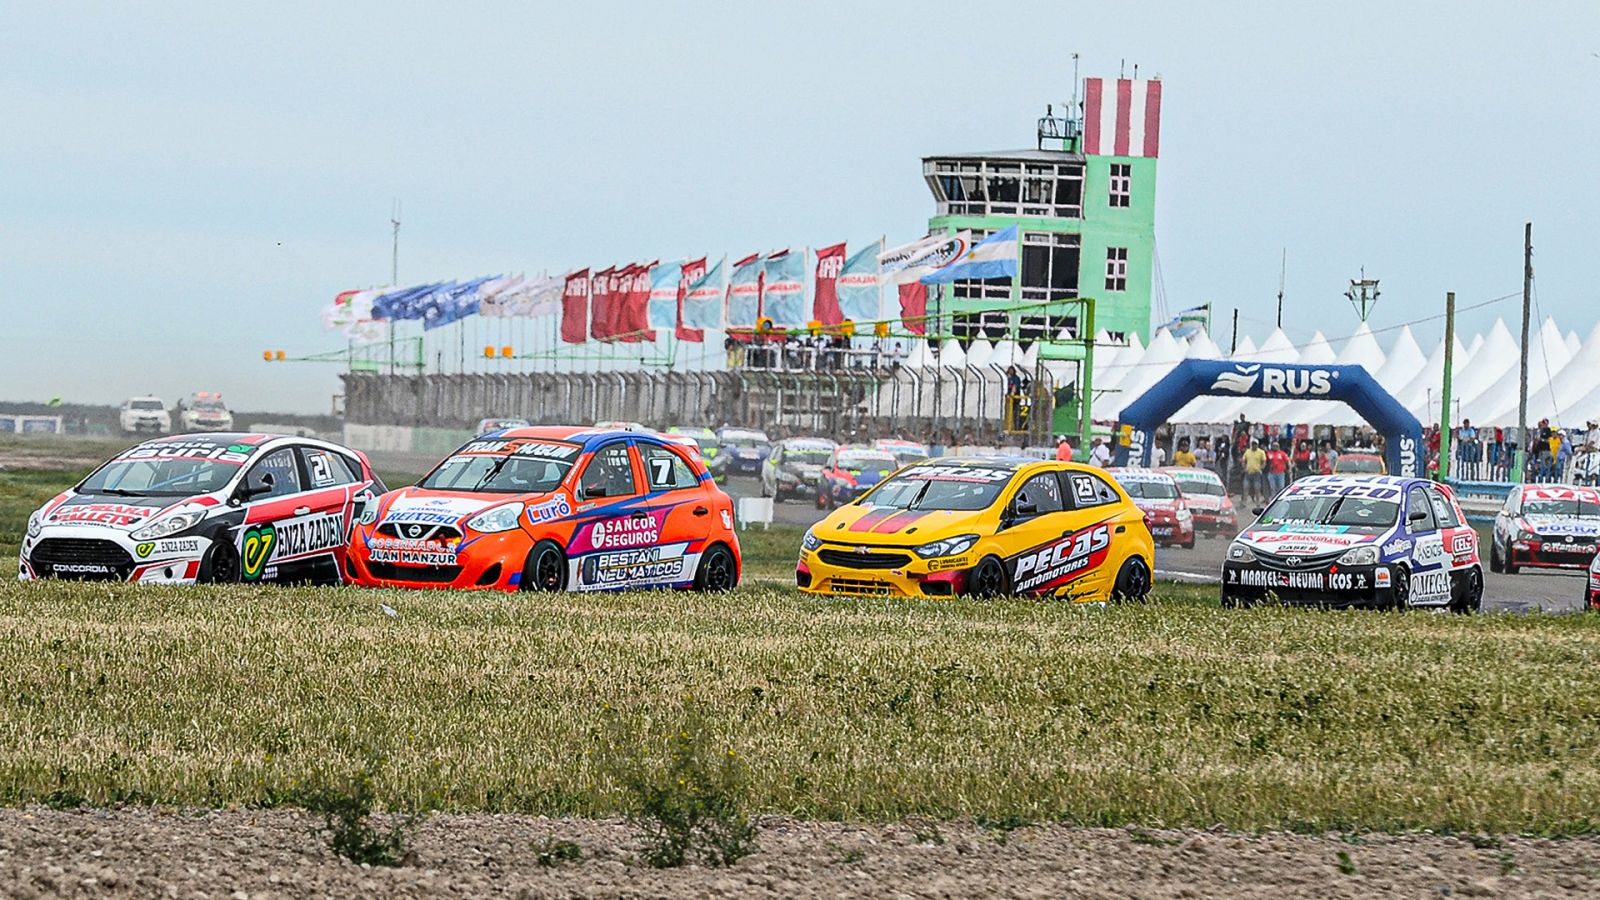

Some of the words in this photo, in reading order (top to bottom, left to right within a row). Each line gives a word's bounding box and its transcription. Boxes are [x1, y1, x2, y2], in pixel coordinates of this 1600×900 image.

[1262, 368, 1331, 395] RUS
[311, 455, 333, 480] 21
[1400, 438, 1415, 477] RUS
[652, 459, 671, 484] 7
[898, 466, 1015, 481] PECAS
[1076, 478, 1094, 496] 25
[527, 503, 570, 524] Luro
[606, 517, 657, 533] SANCOR
[161, 541, 178, 553] ENZA
[179, 539, 199, 552] ZADEN
[277, 522, 307, 558] ENZA
[308, 514, 344, 550] ZADEN
[605, 529, 658, 547] SEGUROS
[402, 551, 457, 565] MANZUR
[599, 549, 660, 568] BESTANI
[1014, 525, 1110, 583] PECAS
[52, 564, 109, 573] CONCORDIA
[596, 562, 683, 583] NEUMATICOS
[1015, 556, 1089, 593] AUTOMOTORES
[1240, 569, 1278, 588] MARKEL
[1288, 572, 1352, 591] NEUMAICOS
[1411, 572, 1451, 599] OMEGA
